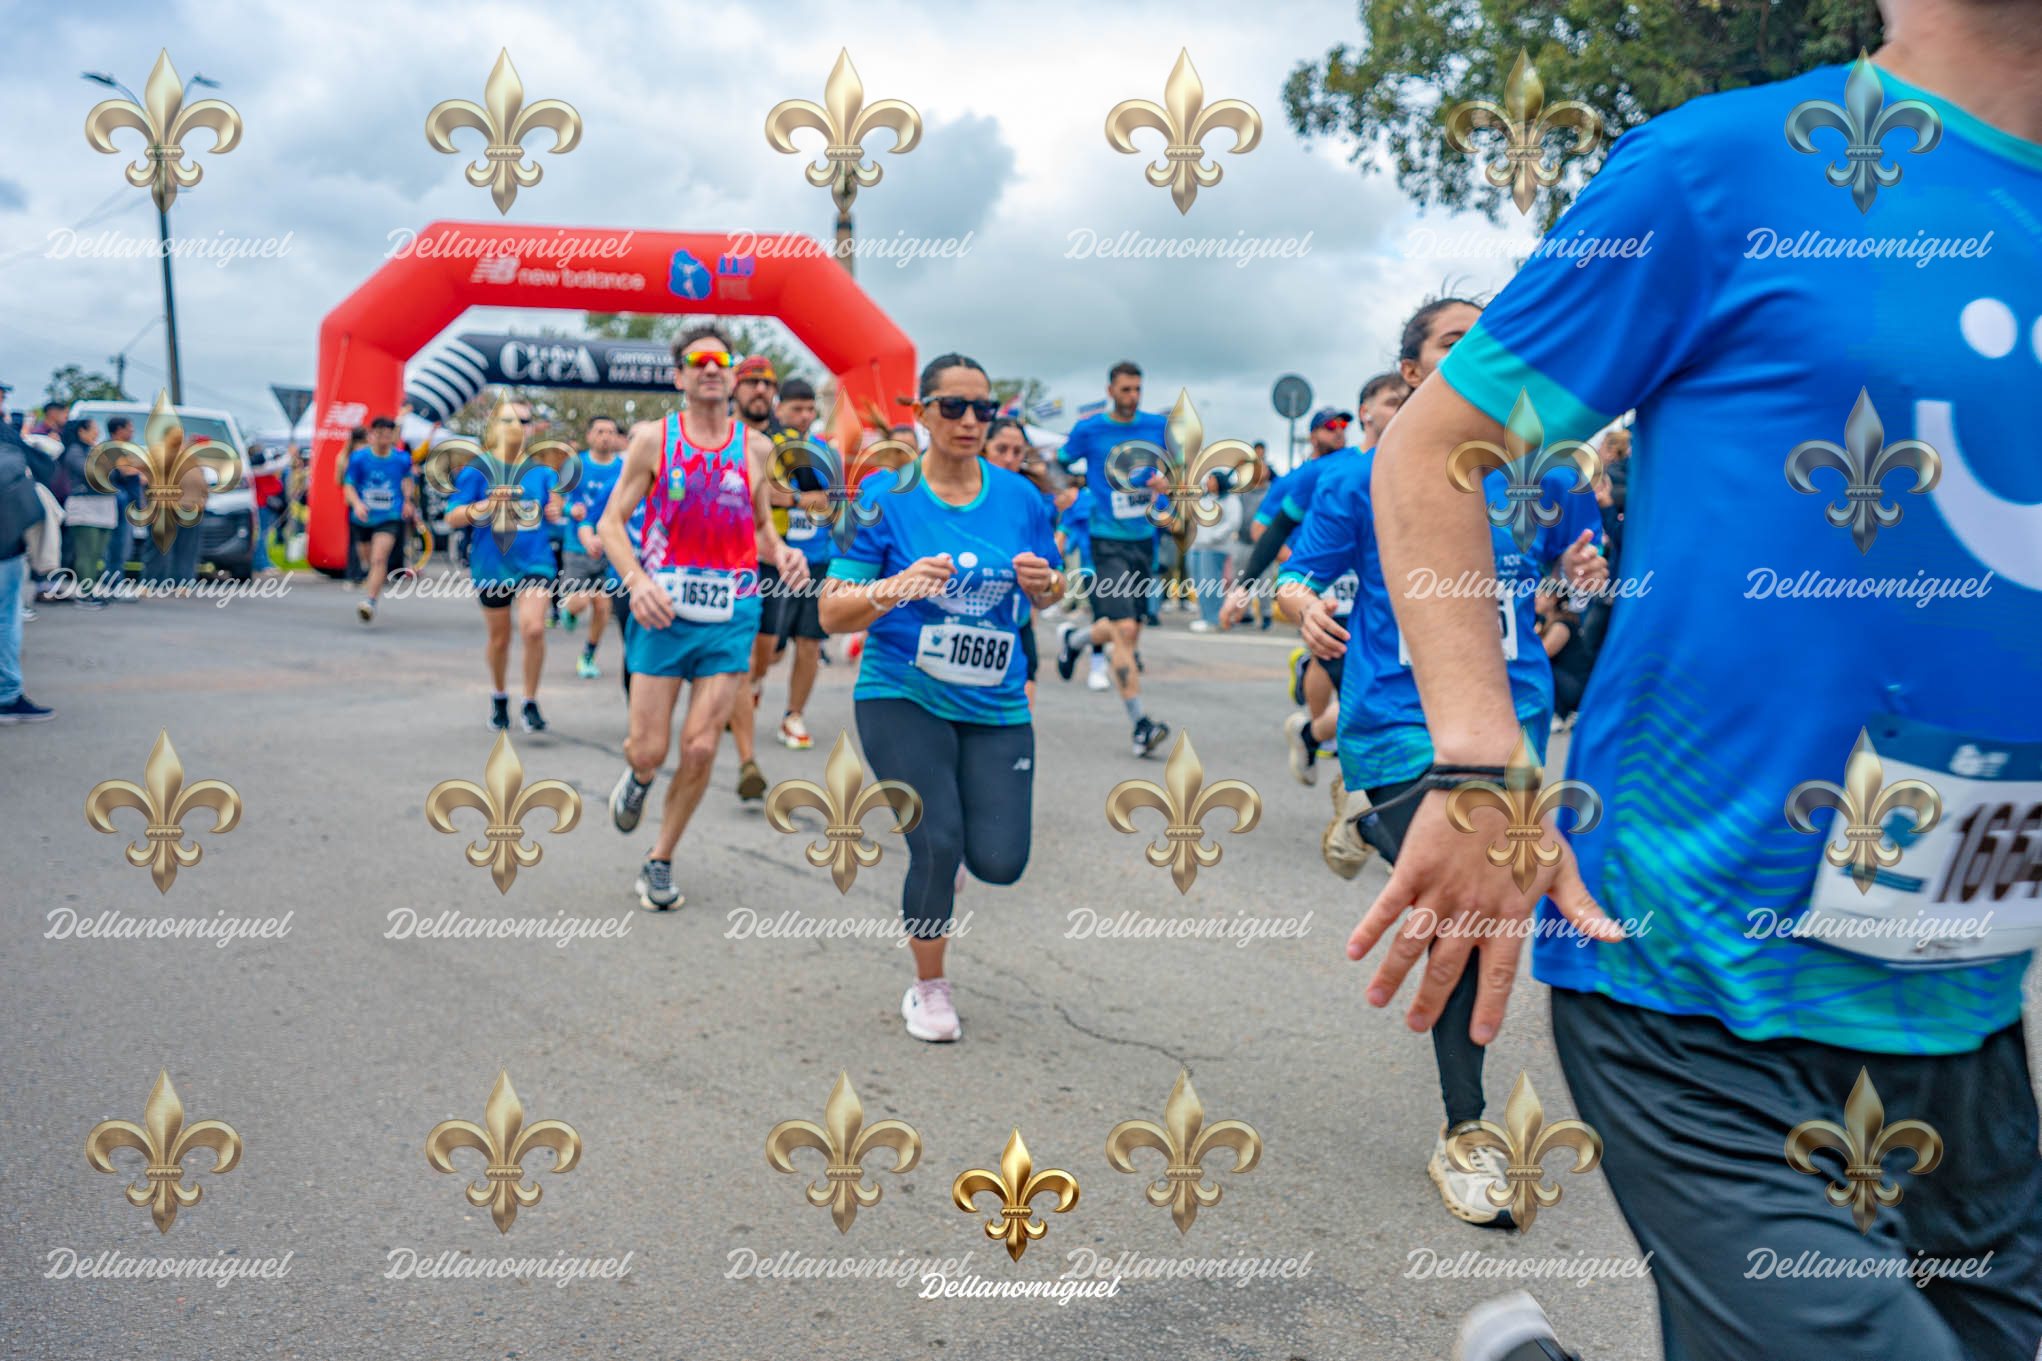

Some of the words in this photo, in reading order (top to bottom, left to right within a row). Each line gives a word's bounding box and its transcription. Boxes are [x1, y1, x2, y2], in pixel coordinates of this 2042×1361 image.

[518, 267, 559, 286] new
[562, 269, 646, 291] balance
[681, 580, 730, 609] 16523
[949, 632, 1010, 671] 16688
